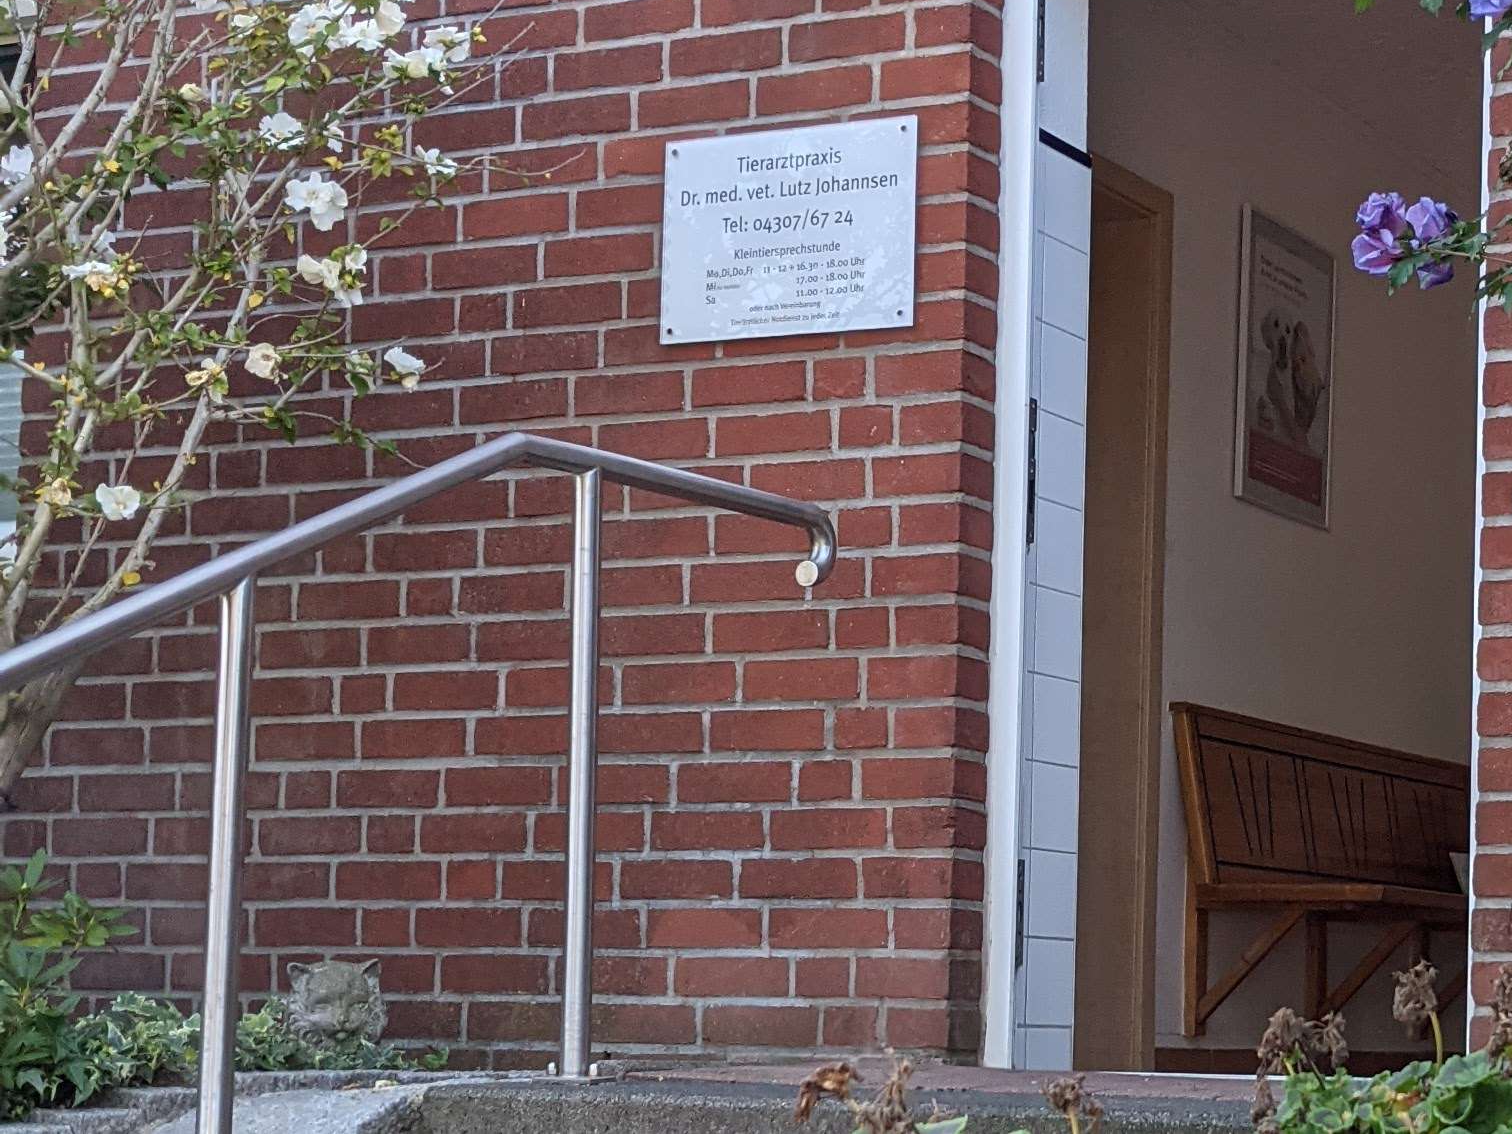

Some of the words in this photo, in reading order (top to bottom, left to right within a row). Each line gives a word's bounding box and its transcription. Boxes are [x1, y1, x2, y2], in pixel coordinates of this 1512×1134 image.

[737, 147, 842, 173] Tierarztpraxis
[680, 190, 700, 207] Dr.
[705, 185, 742, 205] med.
[747, 183, 774, 200] vet.
[780, 180, 811, 197] Lutz
[816, 173, 899, 196] Johannsen
[723, 215, 748, 233] Tel:
[753, 209, 829, 233] 04307/67
[834, 210, 853, 225] 24
[734, 241, 841, 260] Kleintiersprechstunde
[850, 257, 865, 267] Uhr
[850, 270, 865, 279] Uhr
[705, 295, 716, 305] Sa
[850, 283, 864, 293] Uhr
